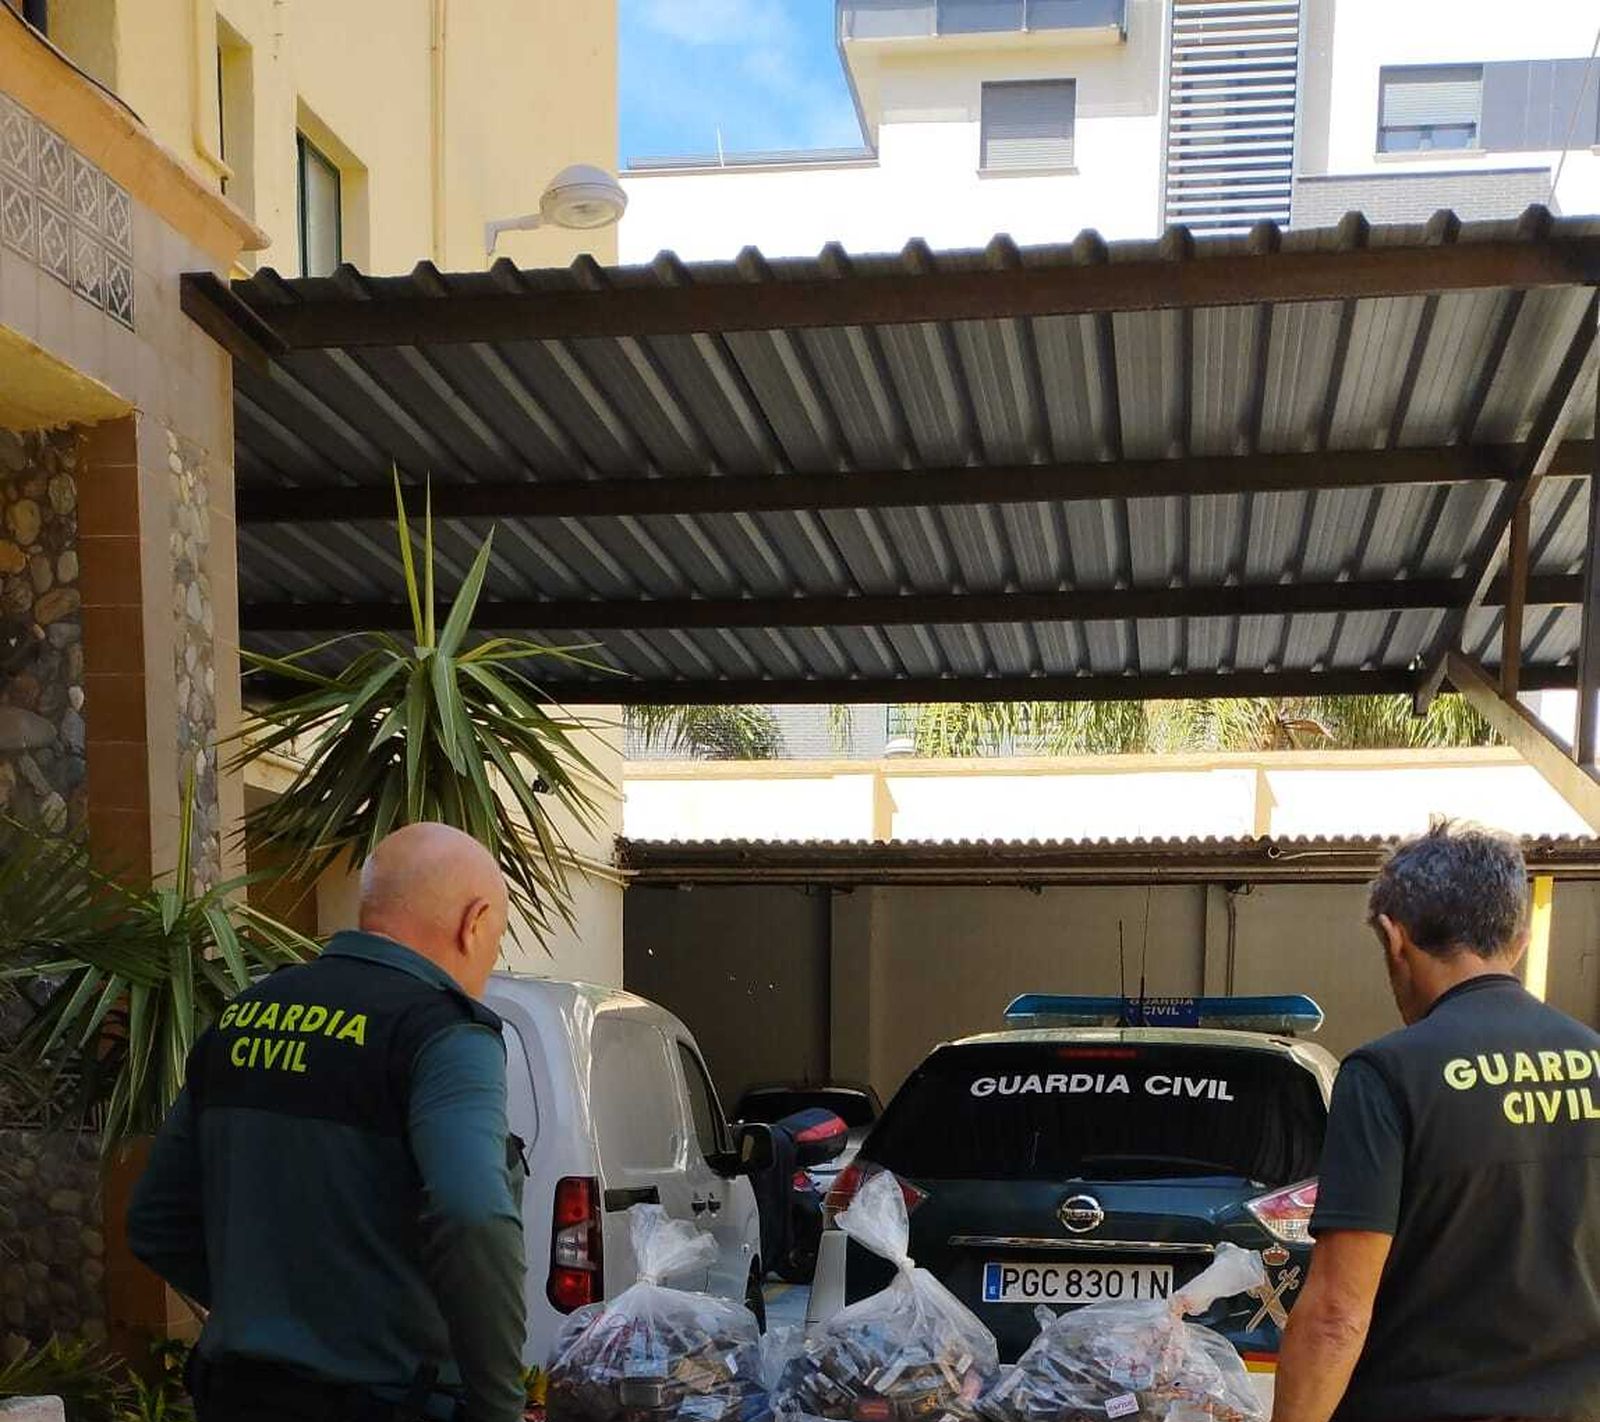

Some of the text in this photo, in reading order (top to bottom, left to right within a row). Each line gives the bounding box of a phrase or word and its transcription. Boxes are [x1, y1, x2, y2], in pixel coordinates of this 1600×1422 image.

[219, 1001, 367, 1045] GUARDIA
[231, 1036, 308, 1072] CIVIL
[970, 1074, 1235, 1101] GUARDIA CIVIL
[1503, 1087, 1600, 1124] CIVIL
